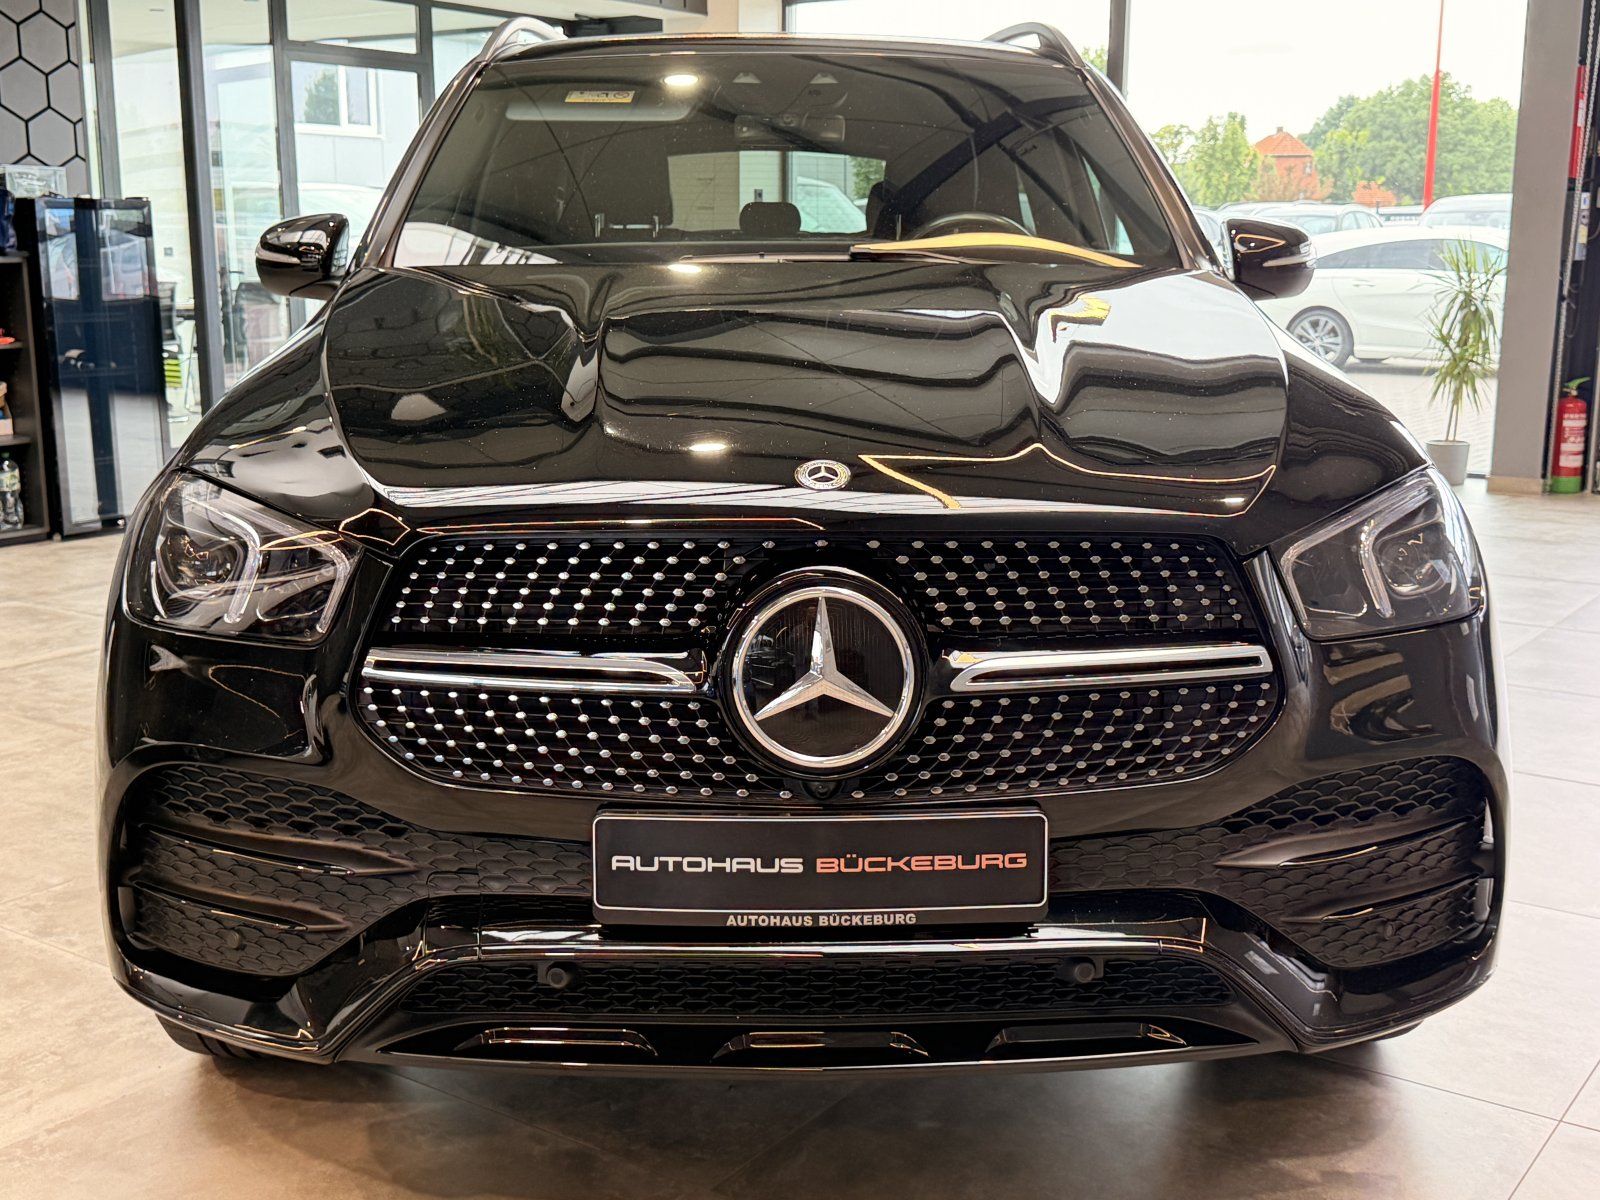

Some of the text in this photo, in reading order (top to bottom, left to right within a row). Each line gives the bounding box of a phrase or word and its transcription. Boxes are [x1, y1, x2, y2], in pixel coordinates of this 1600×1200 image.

[611, 852, 1028, 874] AUTOHAUS BÜCKEBURG
[726, 913, 917, 927] AUTOHAUS BÜCKEBURG
